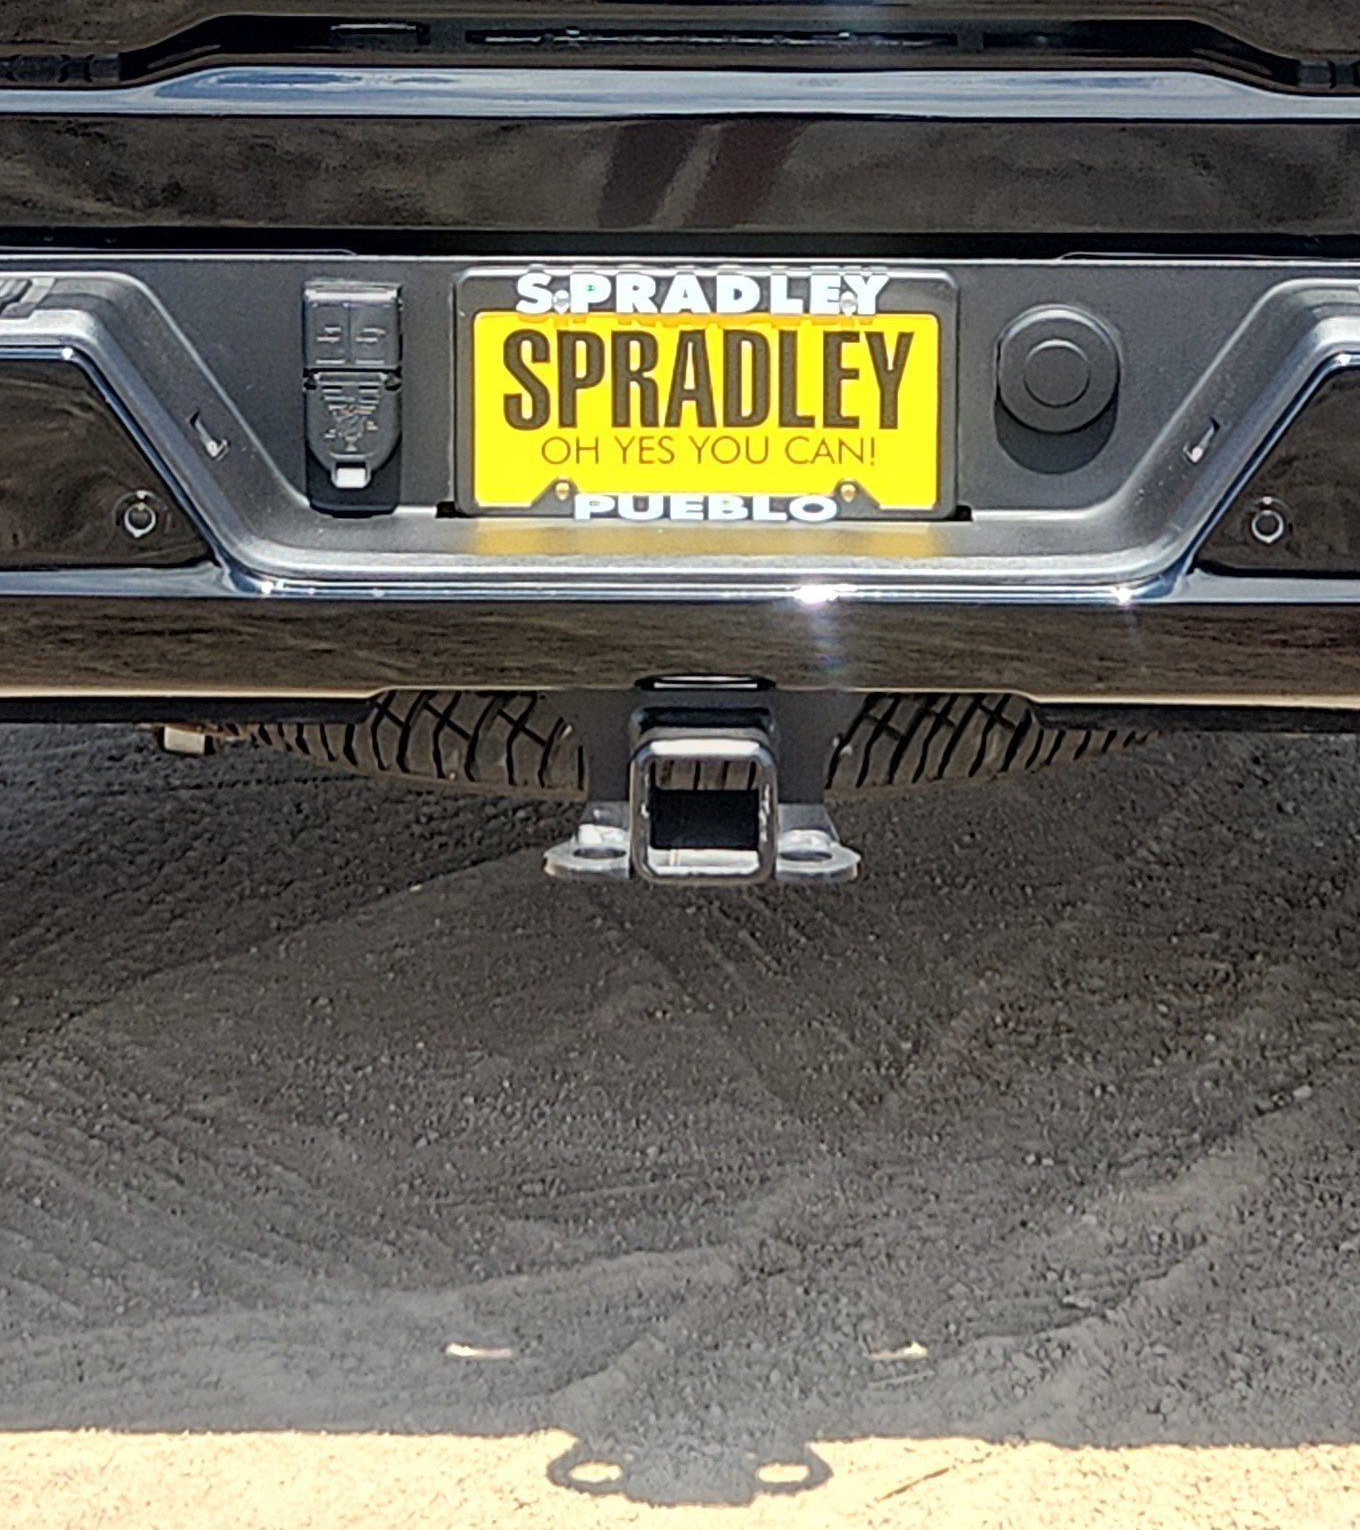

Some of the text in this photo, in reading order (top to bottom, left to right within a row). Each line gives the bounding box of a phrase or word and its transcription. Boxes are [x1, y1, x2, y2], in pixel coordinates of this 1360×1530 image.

[516, 272, 890, 315] SPRADLEY
[502, 328, 915, 431] SPRADLEY
[541, 435, 877, 467] OH YES YOU CAN!
[574, 493, 838, 523] PUEBLO
